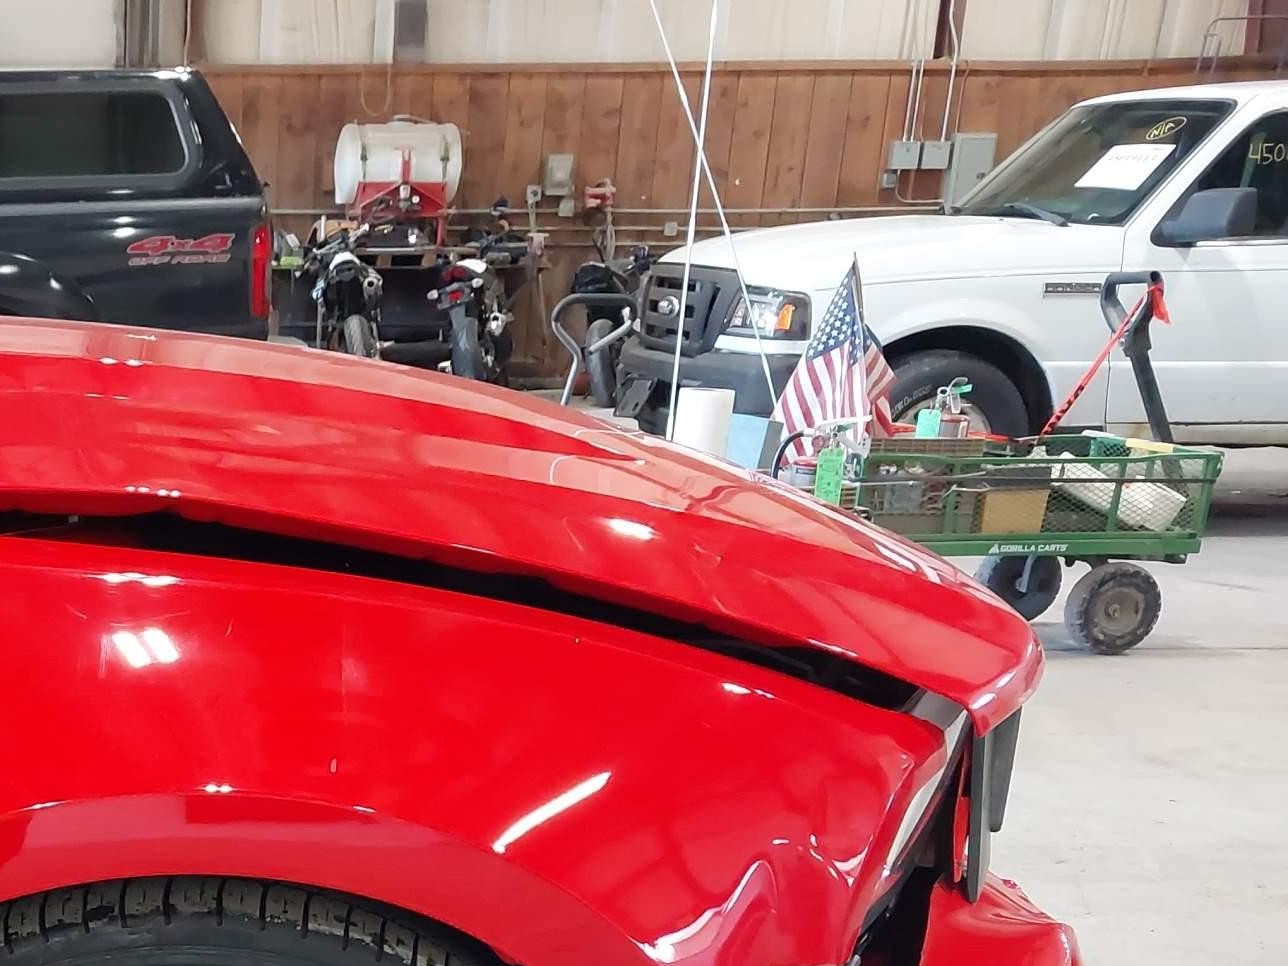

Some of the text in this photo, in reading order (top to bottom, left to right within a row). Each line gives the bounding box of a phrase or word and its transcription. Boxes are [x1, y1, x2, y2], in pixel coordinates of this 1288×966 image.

[1248, 143, 1288, 165] 450
[128, 254, 231, 266] OFF ROAD
[1000, 544, 1066, 553] GORILLA CARTS
